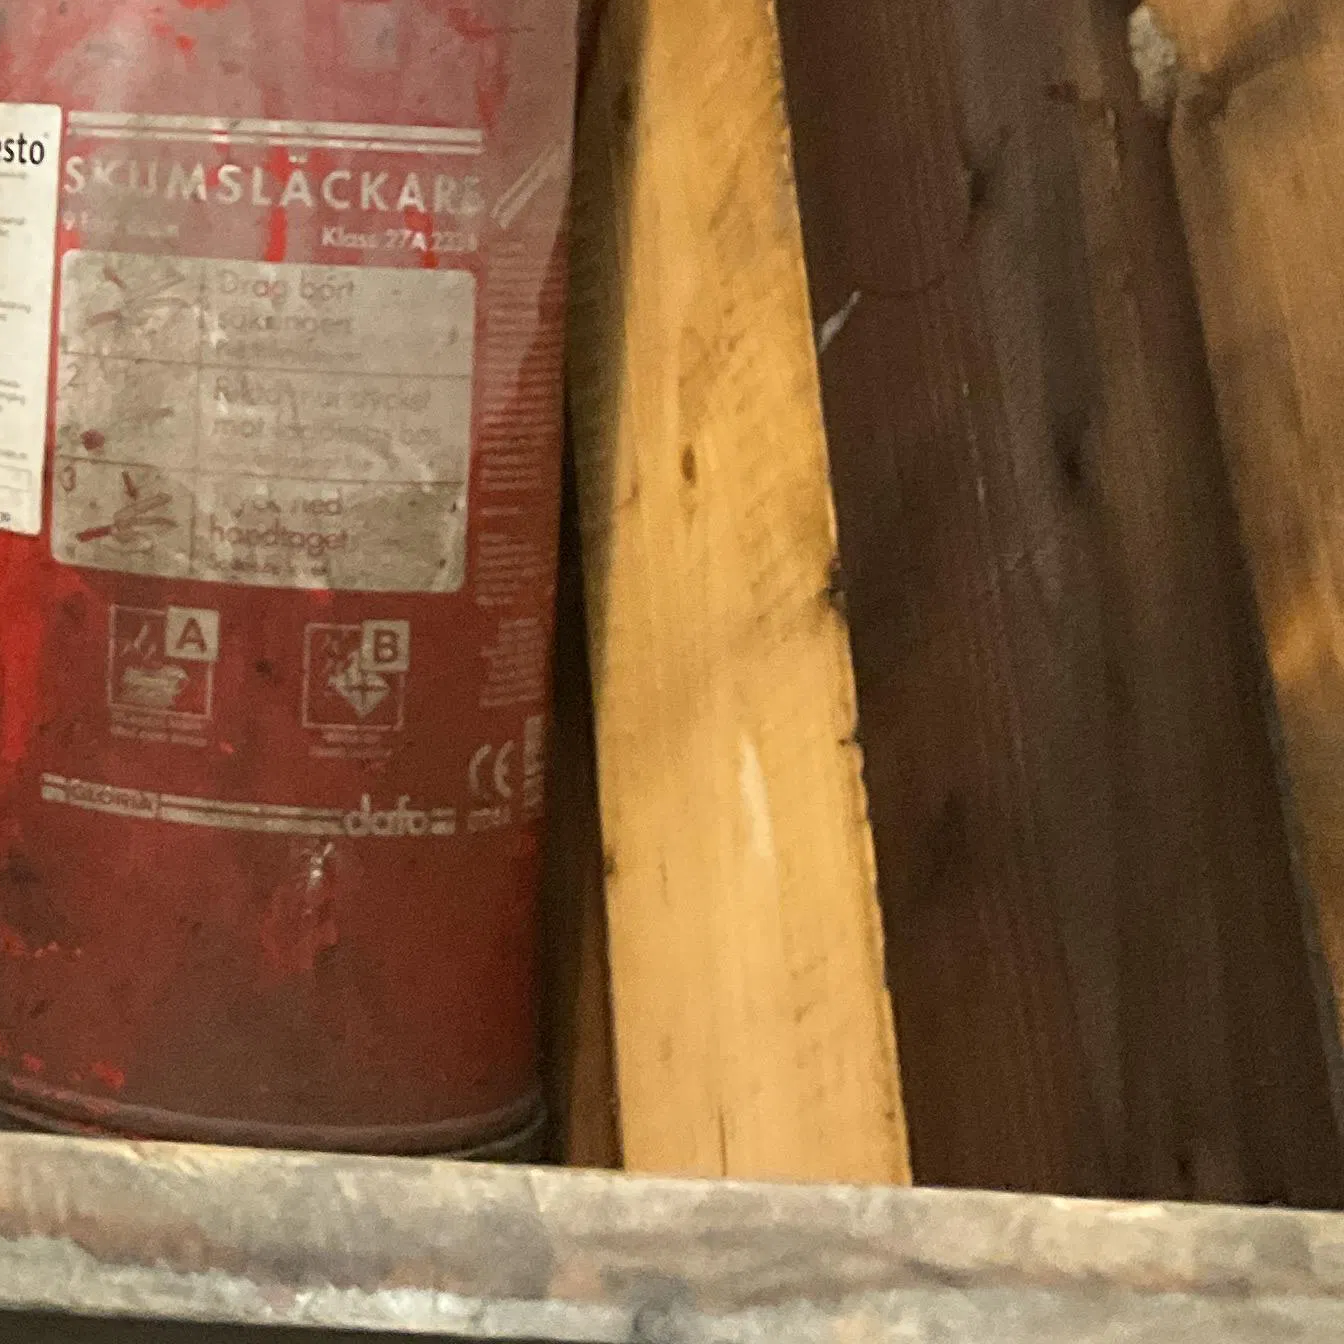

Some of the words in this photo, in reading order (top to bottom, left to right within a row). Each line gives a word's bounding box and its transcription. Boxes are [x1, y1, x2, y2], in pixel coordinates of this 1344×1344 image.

[64, 153, 485, 216] SKUMSLÄCKARE
[175, 617, 208, 653] A
[371, 629, 400, 664] B
[343, 793, 430, 837] dafo
